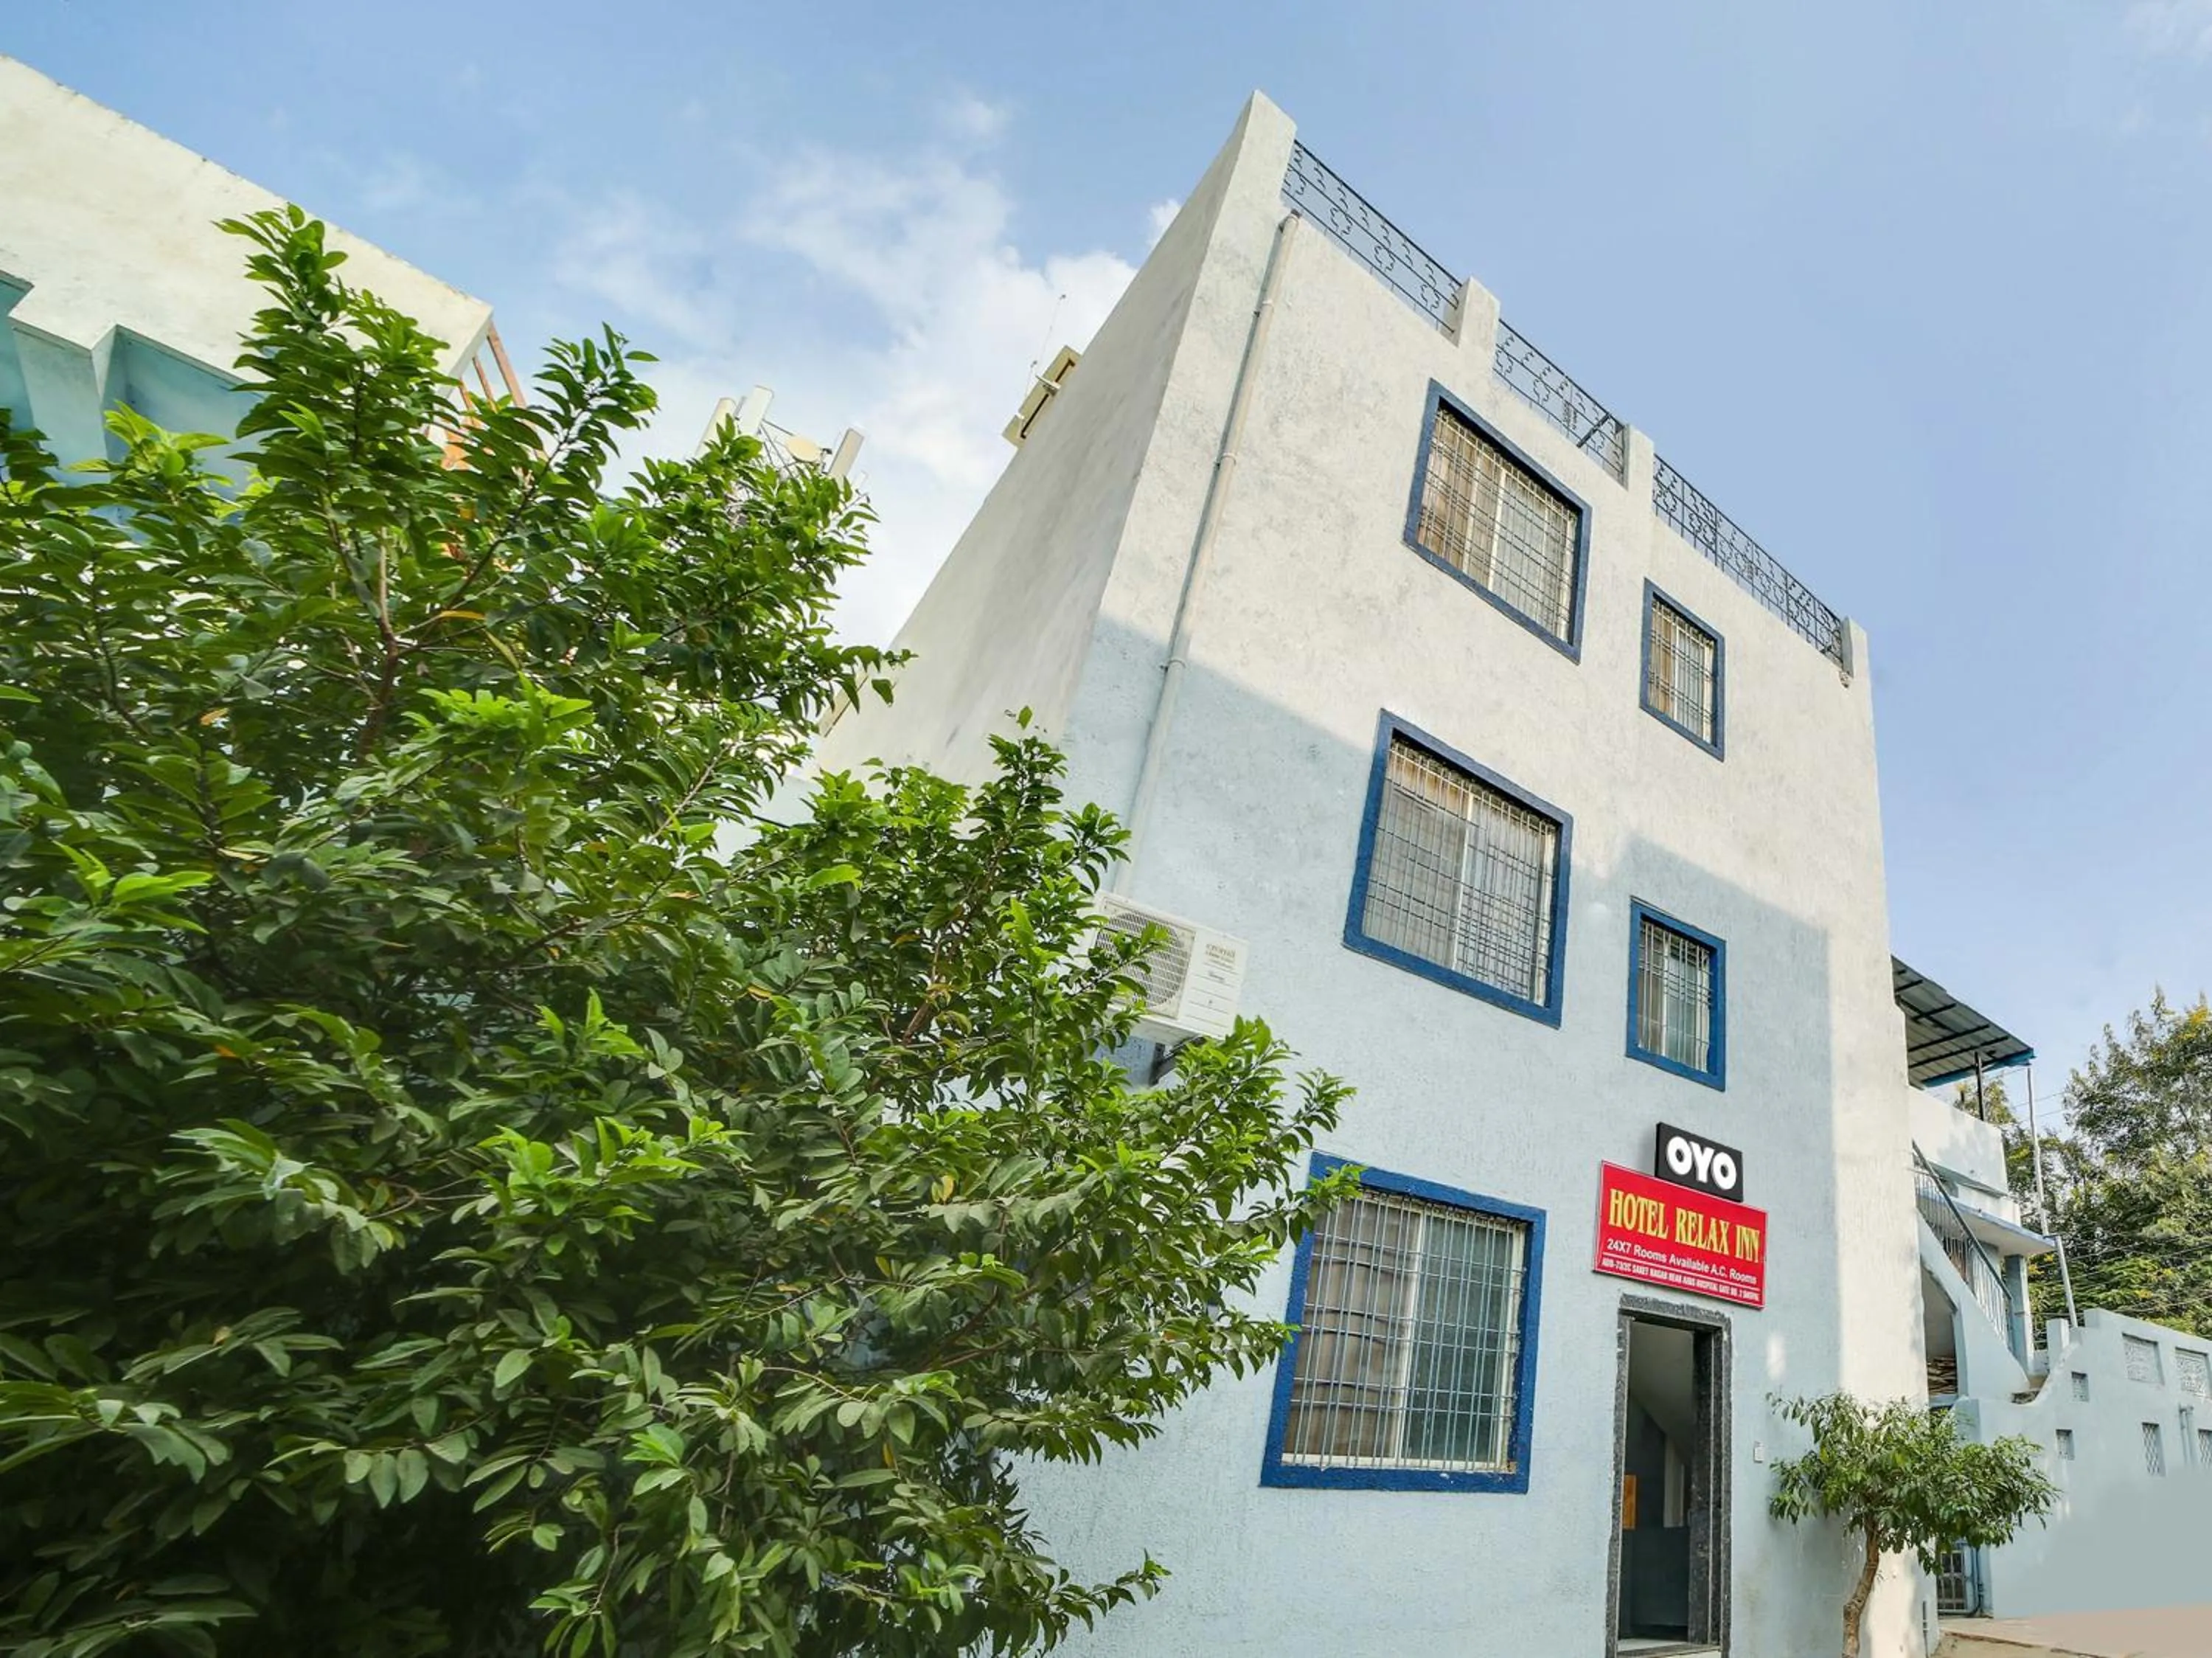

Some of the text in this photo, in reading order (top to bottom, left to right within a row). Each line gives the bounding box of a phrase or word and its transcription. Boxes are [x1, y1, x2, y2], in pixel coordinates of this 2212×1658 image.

[1666, 1135, 1736, 1190] OYO
[1608, 1188, 1761, 1263] HOTEL RELAX INN
[1607, 1238, 1631, 1255] 24X7
[1633, 1246, 1667, 1263] Rooms
[1669, 1255, 1710, 1274] Available
[1729, 1269, 1757, 1285] Rooms
